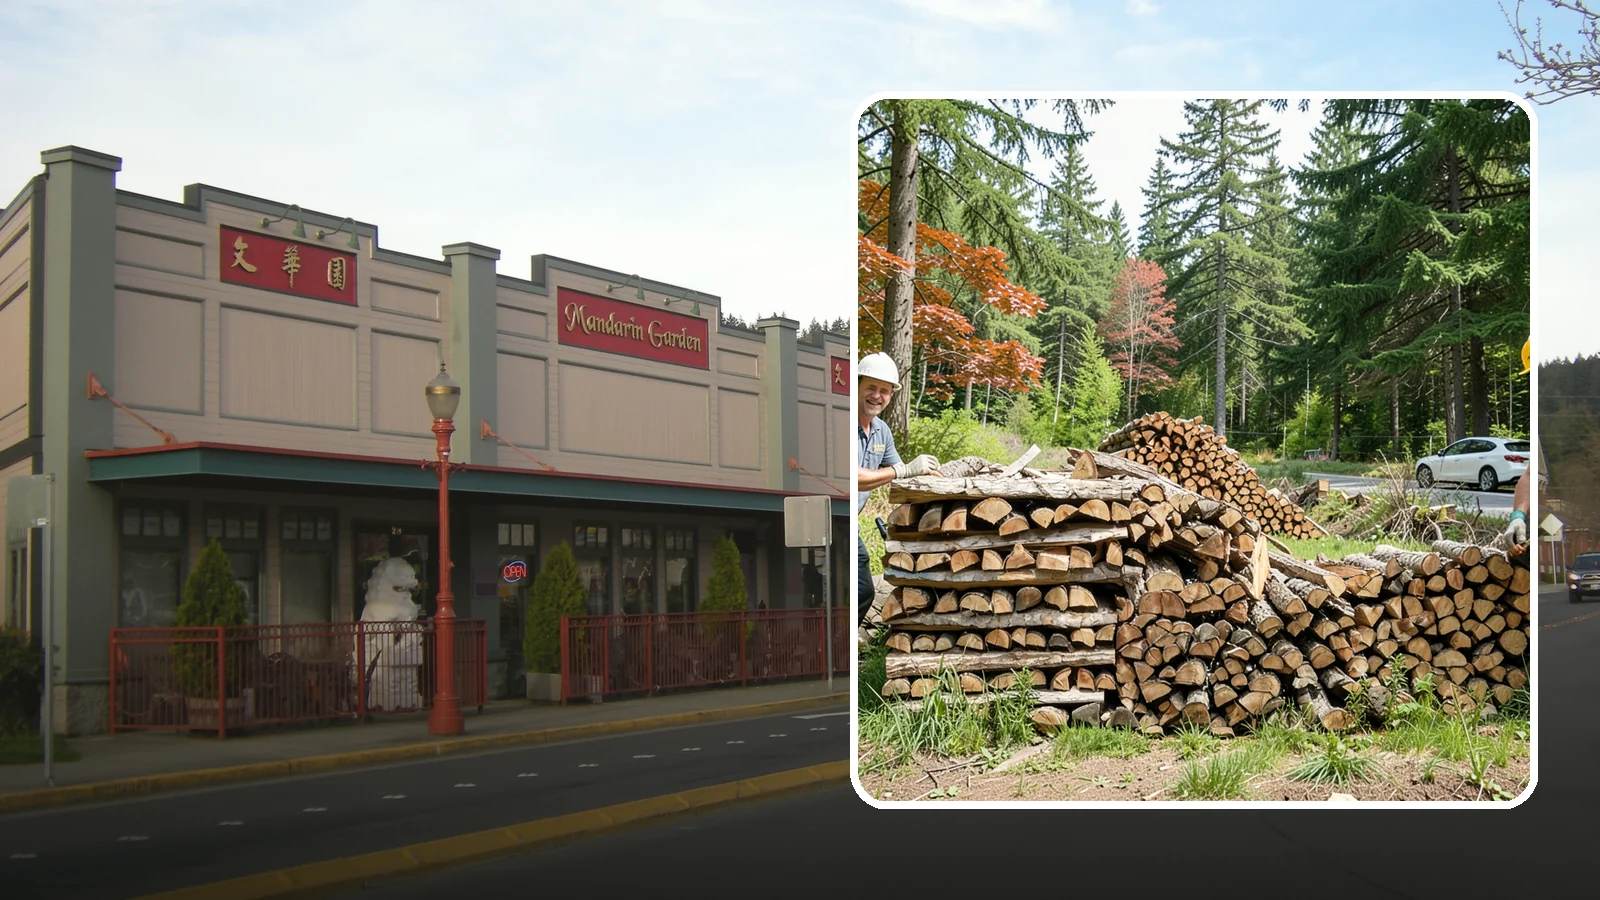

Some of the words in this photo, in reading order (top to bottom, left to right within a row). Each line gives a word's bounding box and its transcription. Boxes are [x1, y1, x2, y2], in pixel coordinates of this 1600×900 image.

[564, 302, 644, 341] Mandarin
[648, 320, 702, 352] Garden
[503, 565, 527, 578] OPEN
